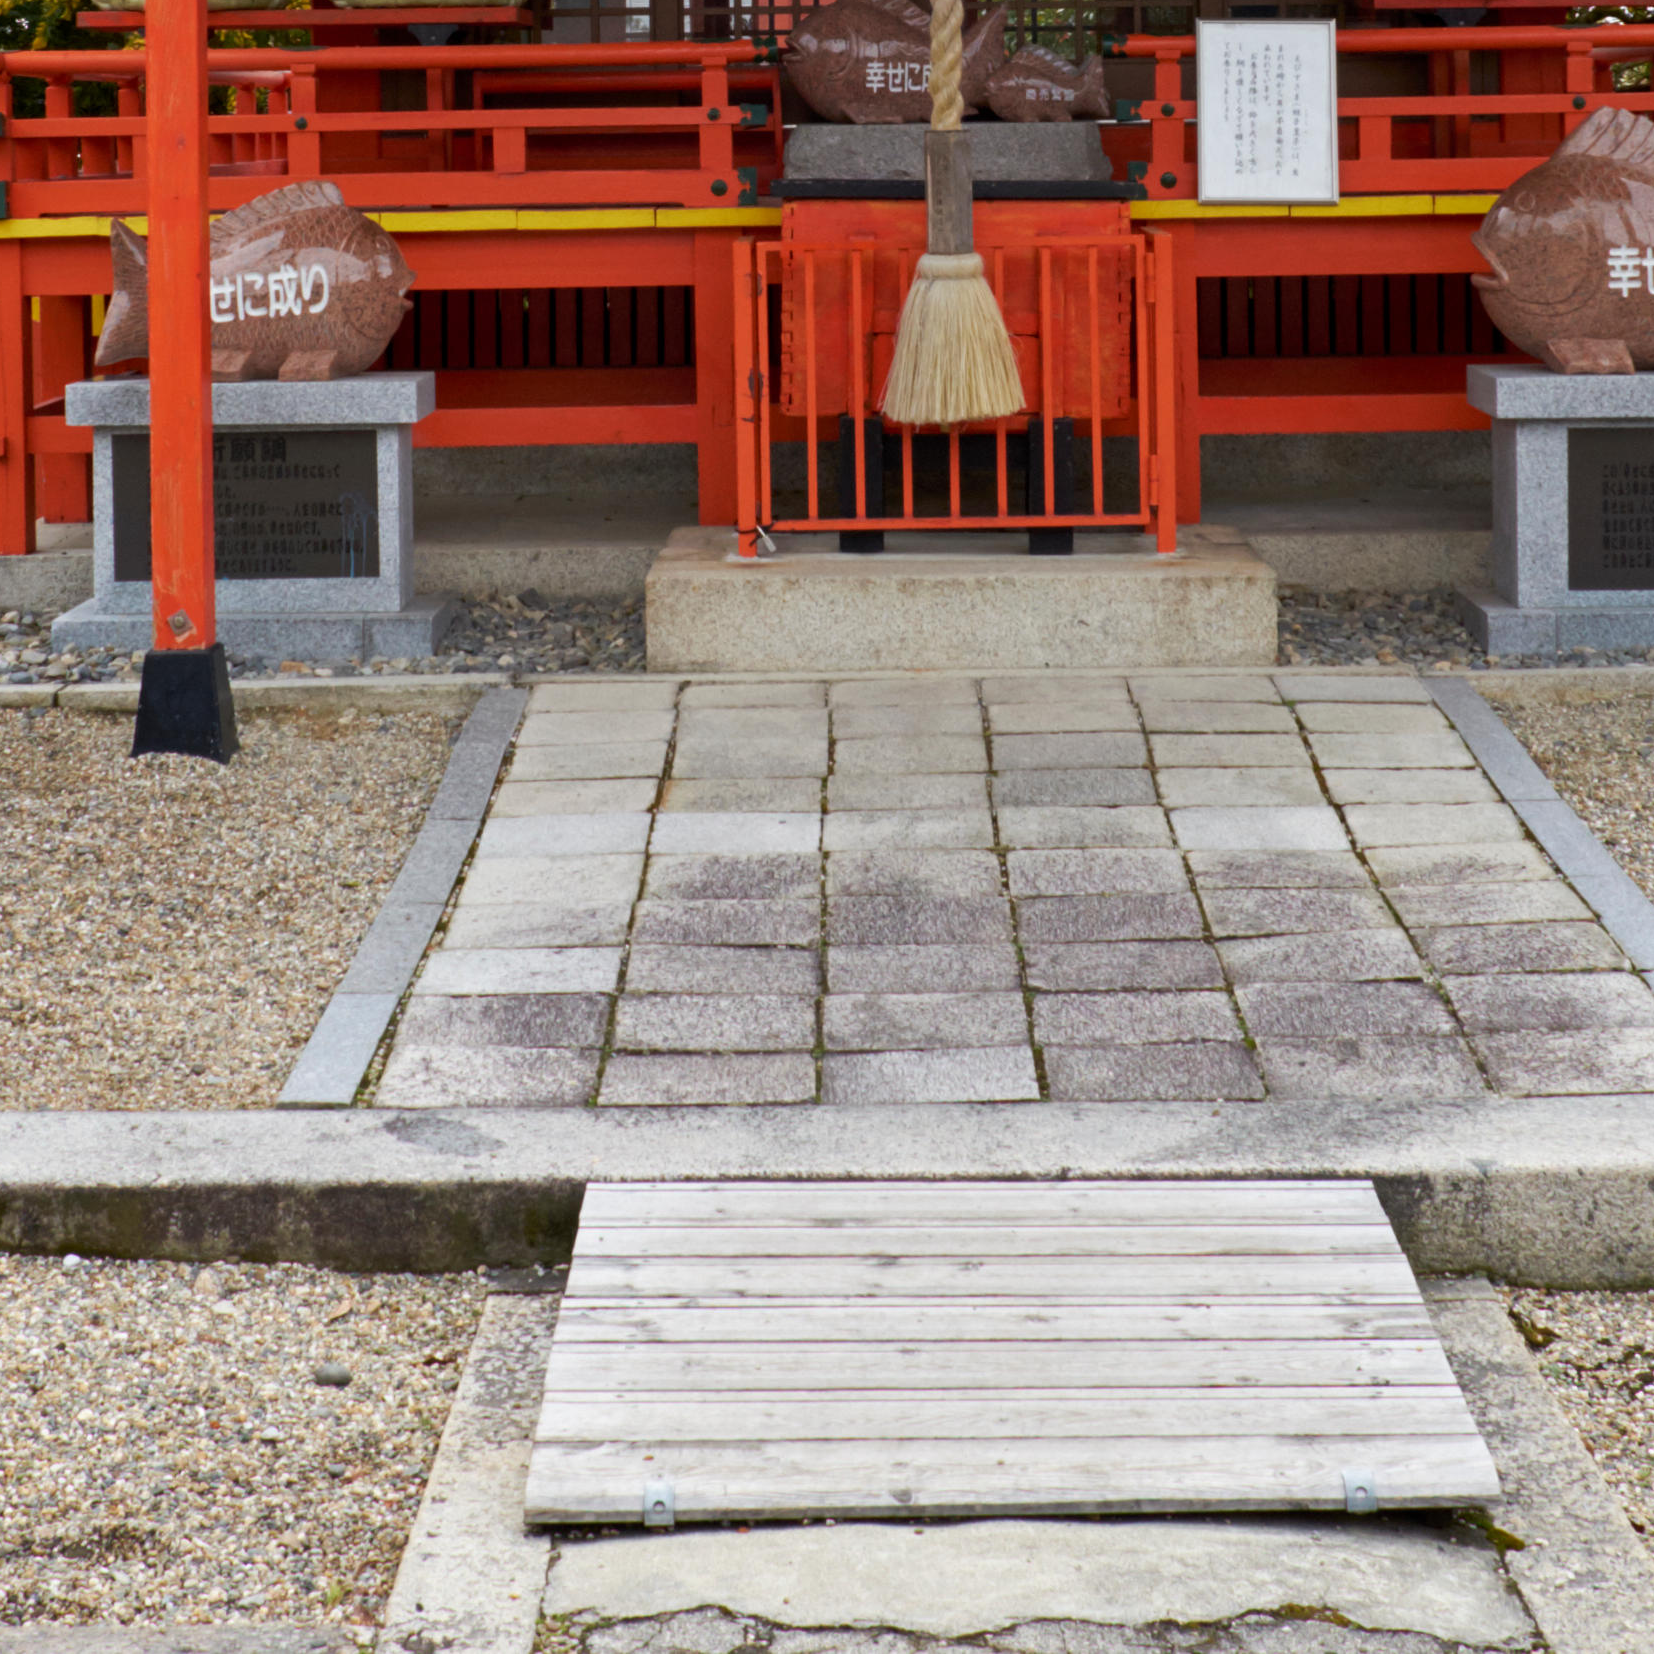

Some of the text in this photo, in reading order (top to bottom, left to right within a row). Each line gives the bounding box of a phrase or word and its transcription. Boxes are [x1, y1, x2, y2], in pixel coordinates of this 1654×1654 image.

[866, 61, 930, 94] 幸せに
[211, 263, 329, 323] せに成り
